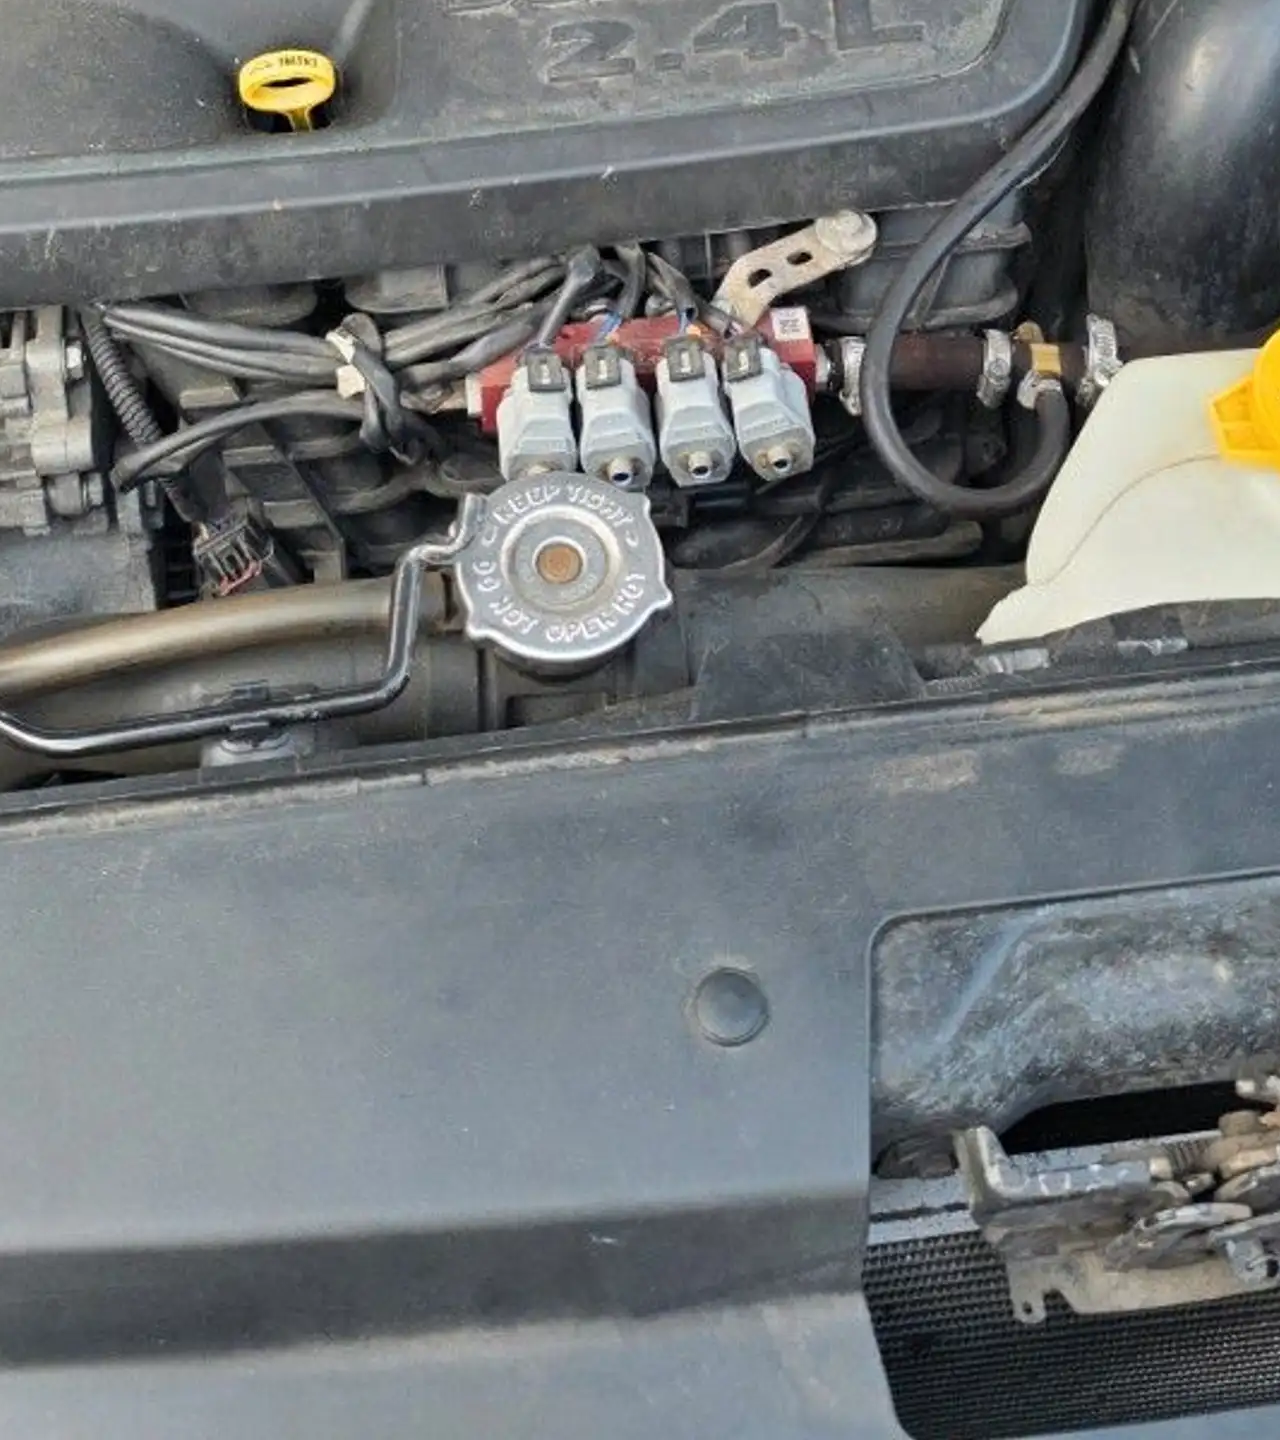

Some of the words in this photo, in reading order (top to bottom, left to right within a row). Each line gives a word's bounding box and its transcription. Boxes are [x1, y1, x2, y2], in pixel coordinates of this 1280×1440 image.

[494, 483, 562, 526] KEEP
[566, 484, 635, 527] TIGHT
[472, 560, 501, 592] DO
[489, 596, 541, 635] NOT
[545, 612, 618, 643] OPEN
[611, 572, 646, 616] HOT
